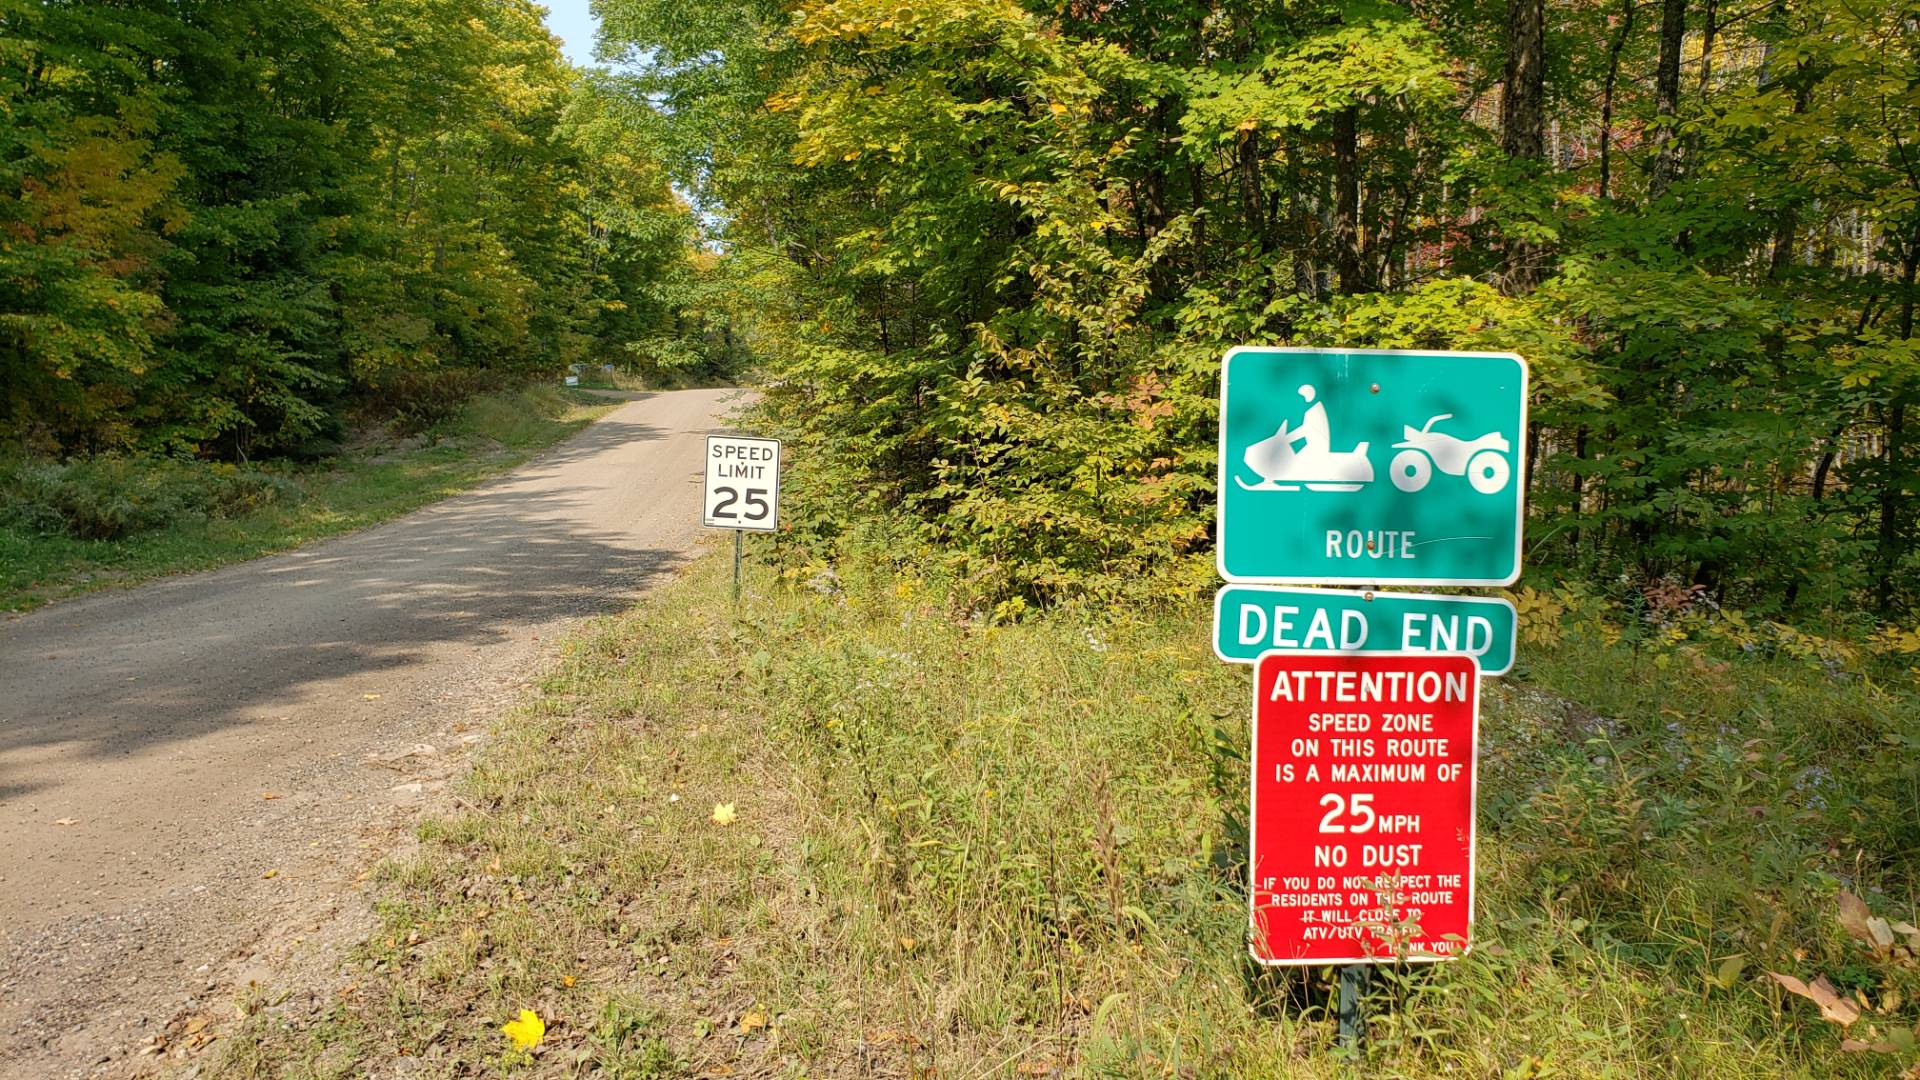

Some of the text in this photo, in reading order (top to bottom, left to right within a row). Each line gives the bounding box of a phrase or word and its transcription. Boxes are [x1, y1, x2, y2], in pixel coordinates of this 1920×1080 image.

[712, 444, 773, 461] SPEED
[718, 463, 765, 479] LIMIT
[712, 486, 769, 520] 25
[1325, 530, 1416, 559] ROUTE
[1238, 604, 1493, 656] DEAD END
[1270, 671, 1467, 703] ATTENTION
[1308, 713, 1433, 732] SPEED ZONE
[1291, 738, 1449, 757] ON THIS ROUTE
[1275, 764, 1463, 782] IS A MAXIMUM OF
[1318, 793, 1420, 833] 25 MPH
[1314, 845, 1422, 867] NO DUST
[1263, 875, 1461, 890] IF YOU DO NOT RESPECT THE
[1271, 891, 1453, 906] RESIDENTS ON THIS ROUTE
[1303, 910, 1315, 923] IT
[1321, 910, 1352, 922] WILL
[1406, 908, 1421, 921] TO
[1303, 926, 1363, 939] ATV/UTV
[1387, 942, 1425, 955] TNK
